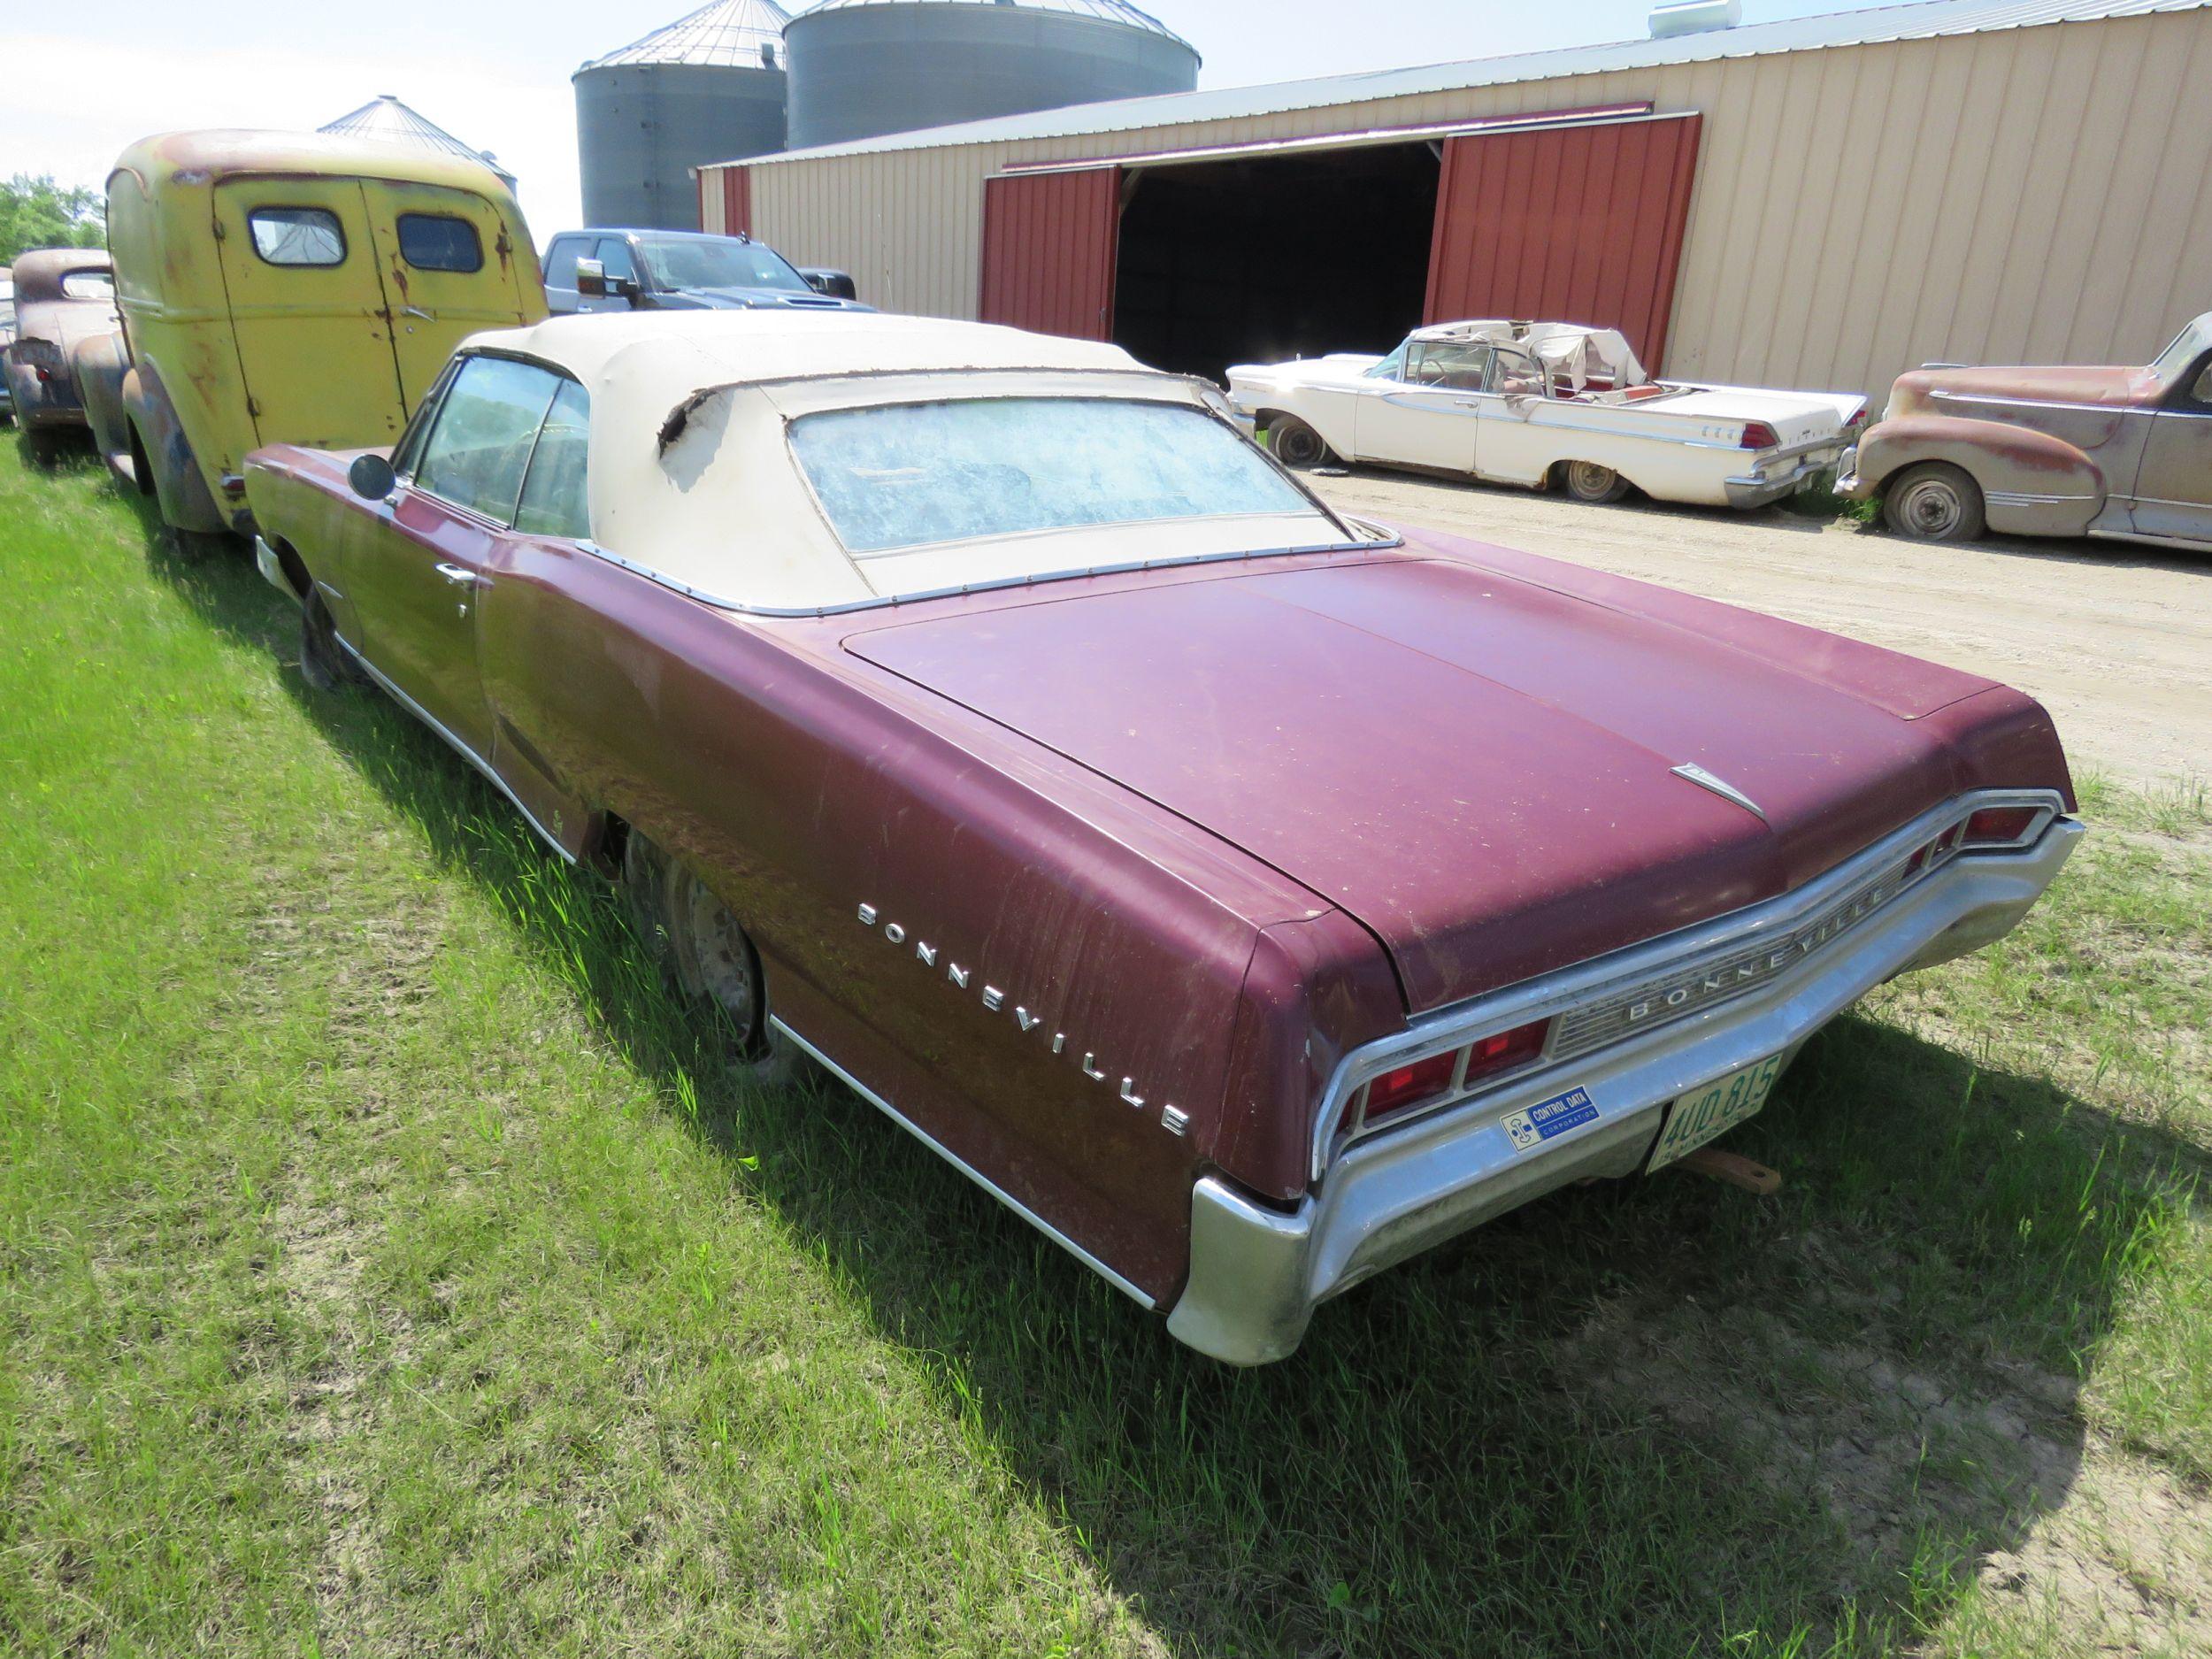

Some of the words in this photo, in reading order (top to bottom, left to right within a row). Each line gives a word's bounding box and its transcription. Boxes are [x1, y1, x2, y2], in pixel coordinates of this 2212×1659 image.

[1629, 887, 1883, 1020] BONNEVILLE
[857, 902, 1189, 1138] BONNEVILLE
[1532, 1100, 1569, 1122] CONTROL
[1566, 1092, 1587, 1108] DATA
[1722, 1056, 1779, 1118] 815
[1543, 1110, 1596, 1135] CORPORATION
